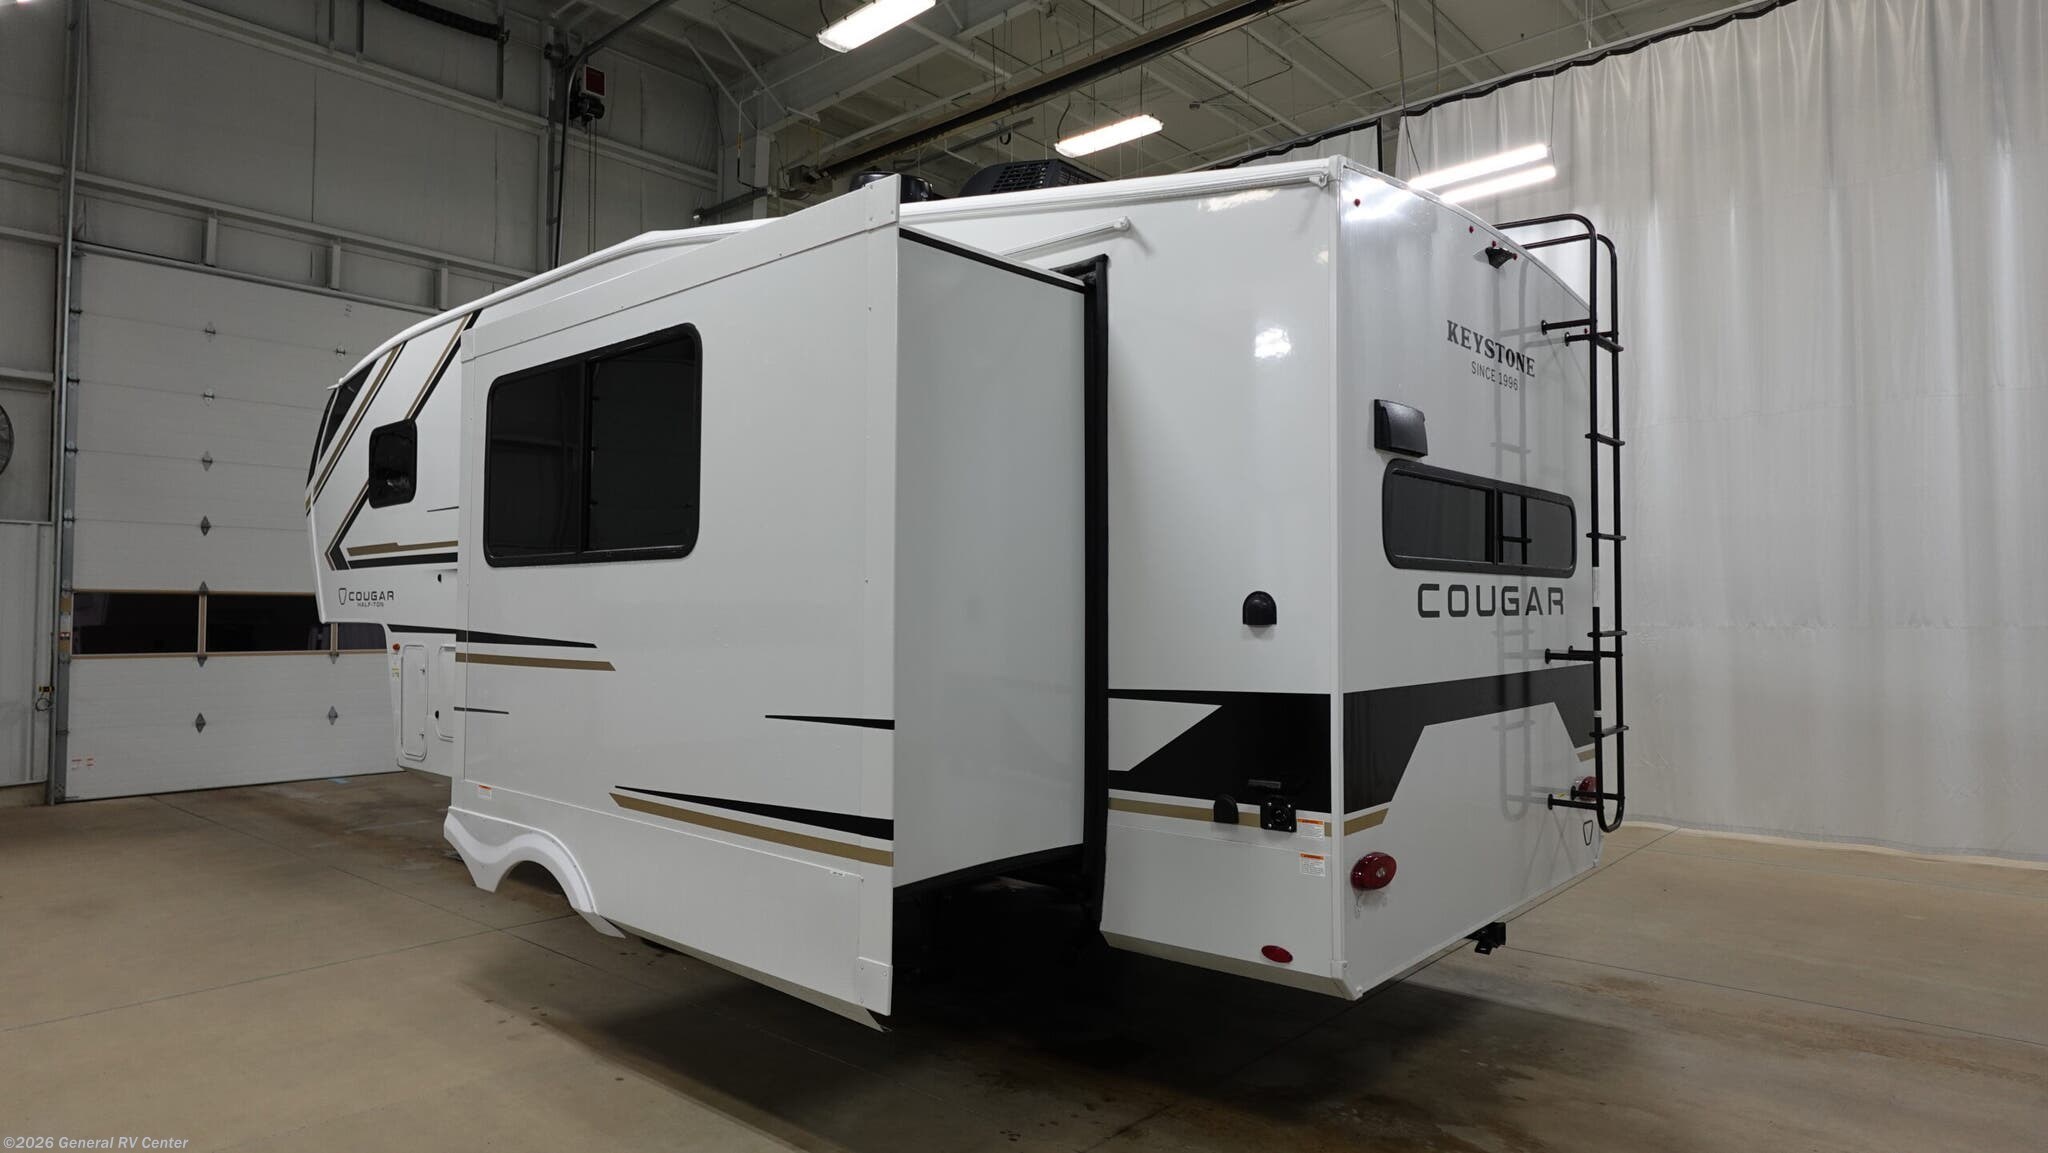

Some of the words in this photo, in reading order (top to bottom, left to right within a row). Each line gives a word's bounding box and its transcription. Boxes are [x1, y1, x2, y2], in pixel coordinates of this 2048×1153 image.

[1447, 320, 1535, 378] KEYSTONE
[1471, 361, 1496, 382] SINCE
[1498, 372, 1519, 391] 1996
[349, 591, 394, 602] COUGAR
[1418, 583, 1564, 618] COUGAR
